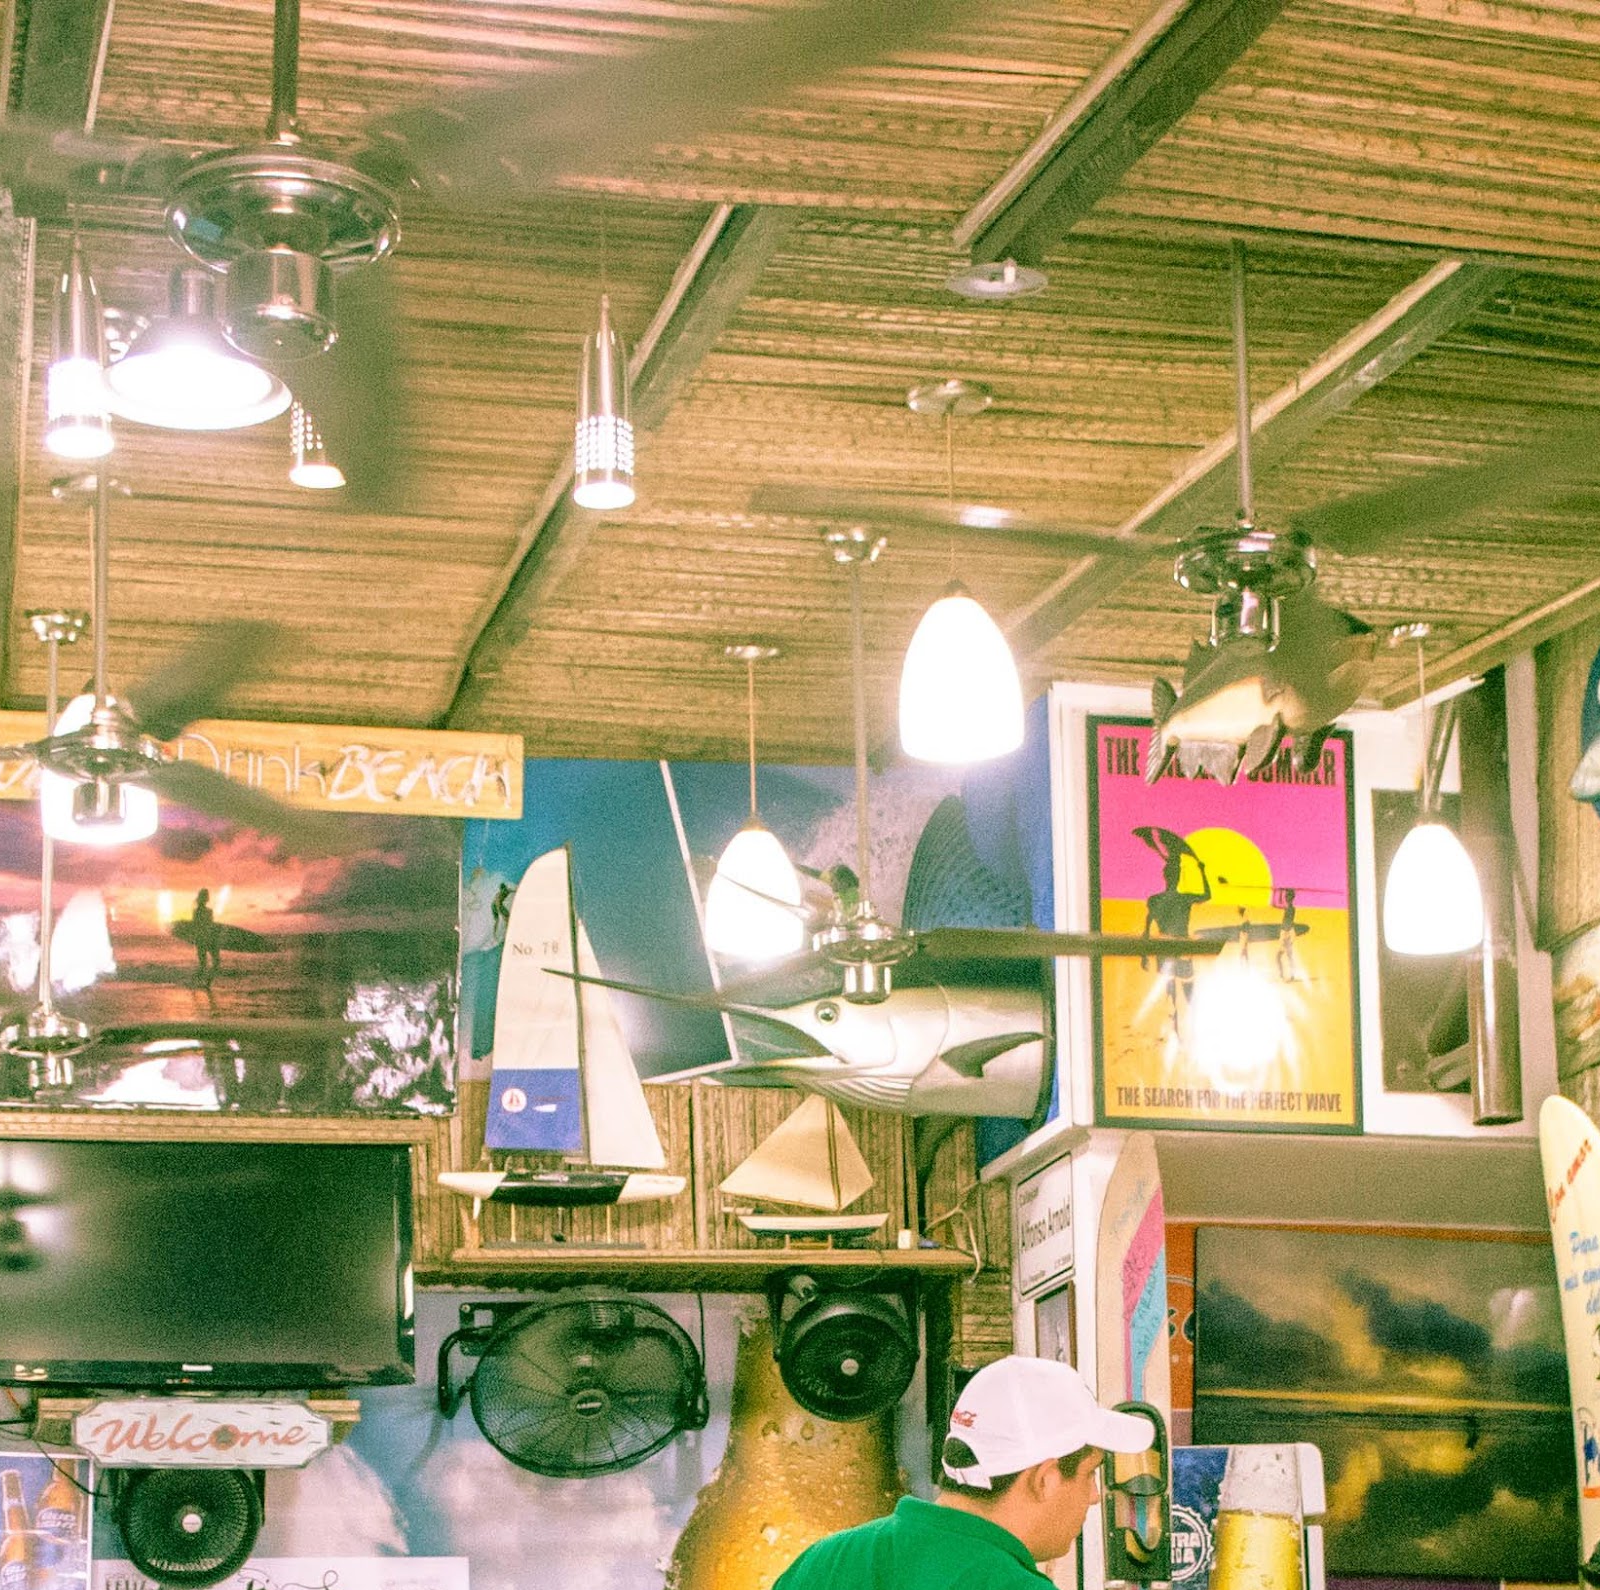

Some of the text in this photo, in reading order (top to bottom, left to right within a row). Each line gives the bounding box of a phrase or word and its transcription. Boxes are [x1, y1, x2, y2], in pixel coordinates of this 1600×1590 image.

[1105, 737, 1139, 775] THE
[1117, 1087, 1342, 1113] THE SEARCH FOR THE PERFECT WAVE
[91, 1413, 311, 1454] Welcome
